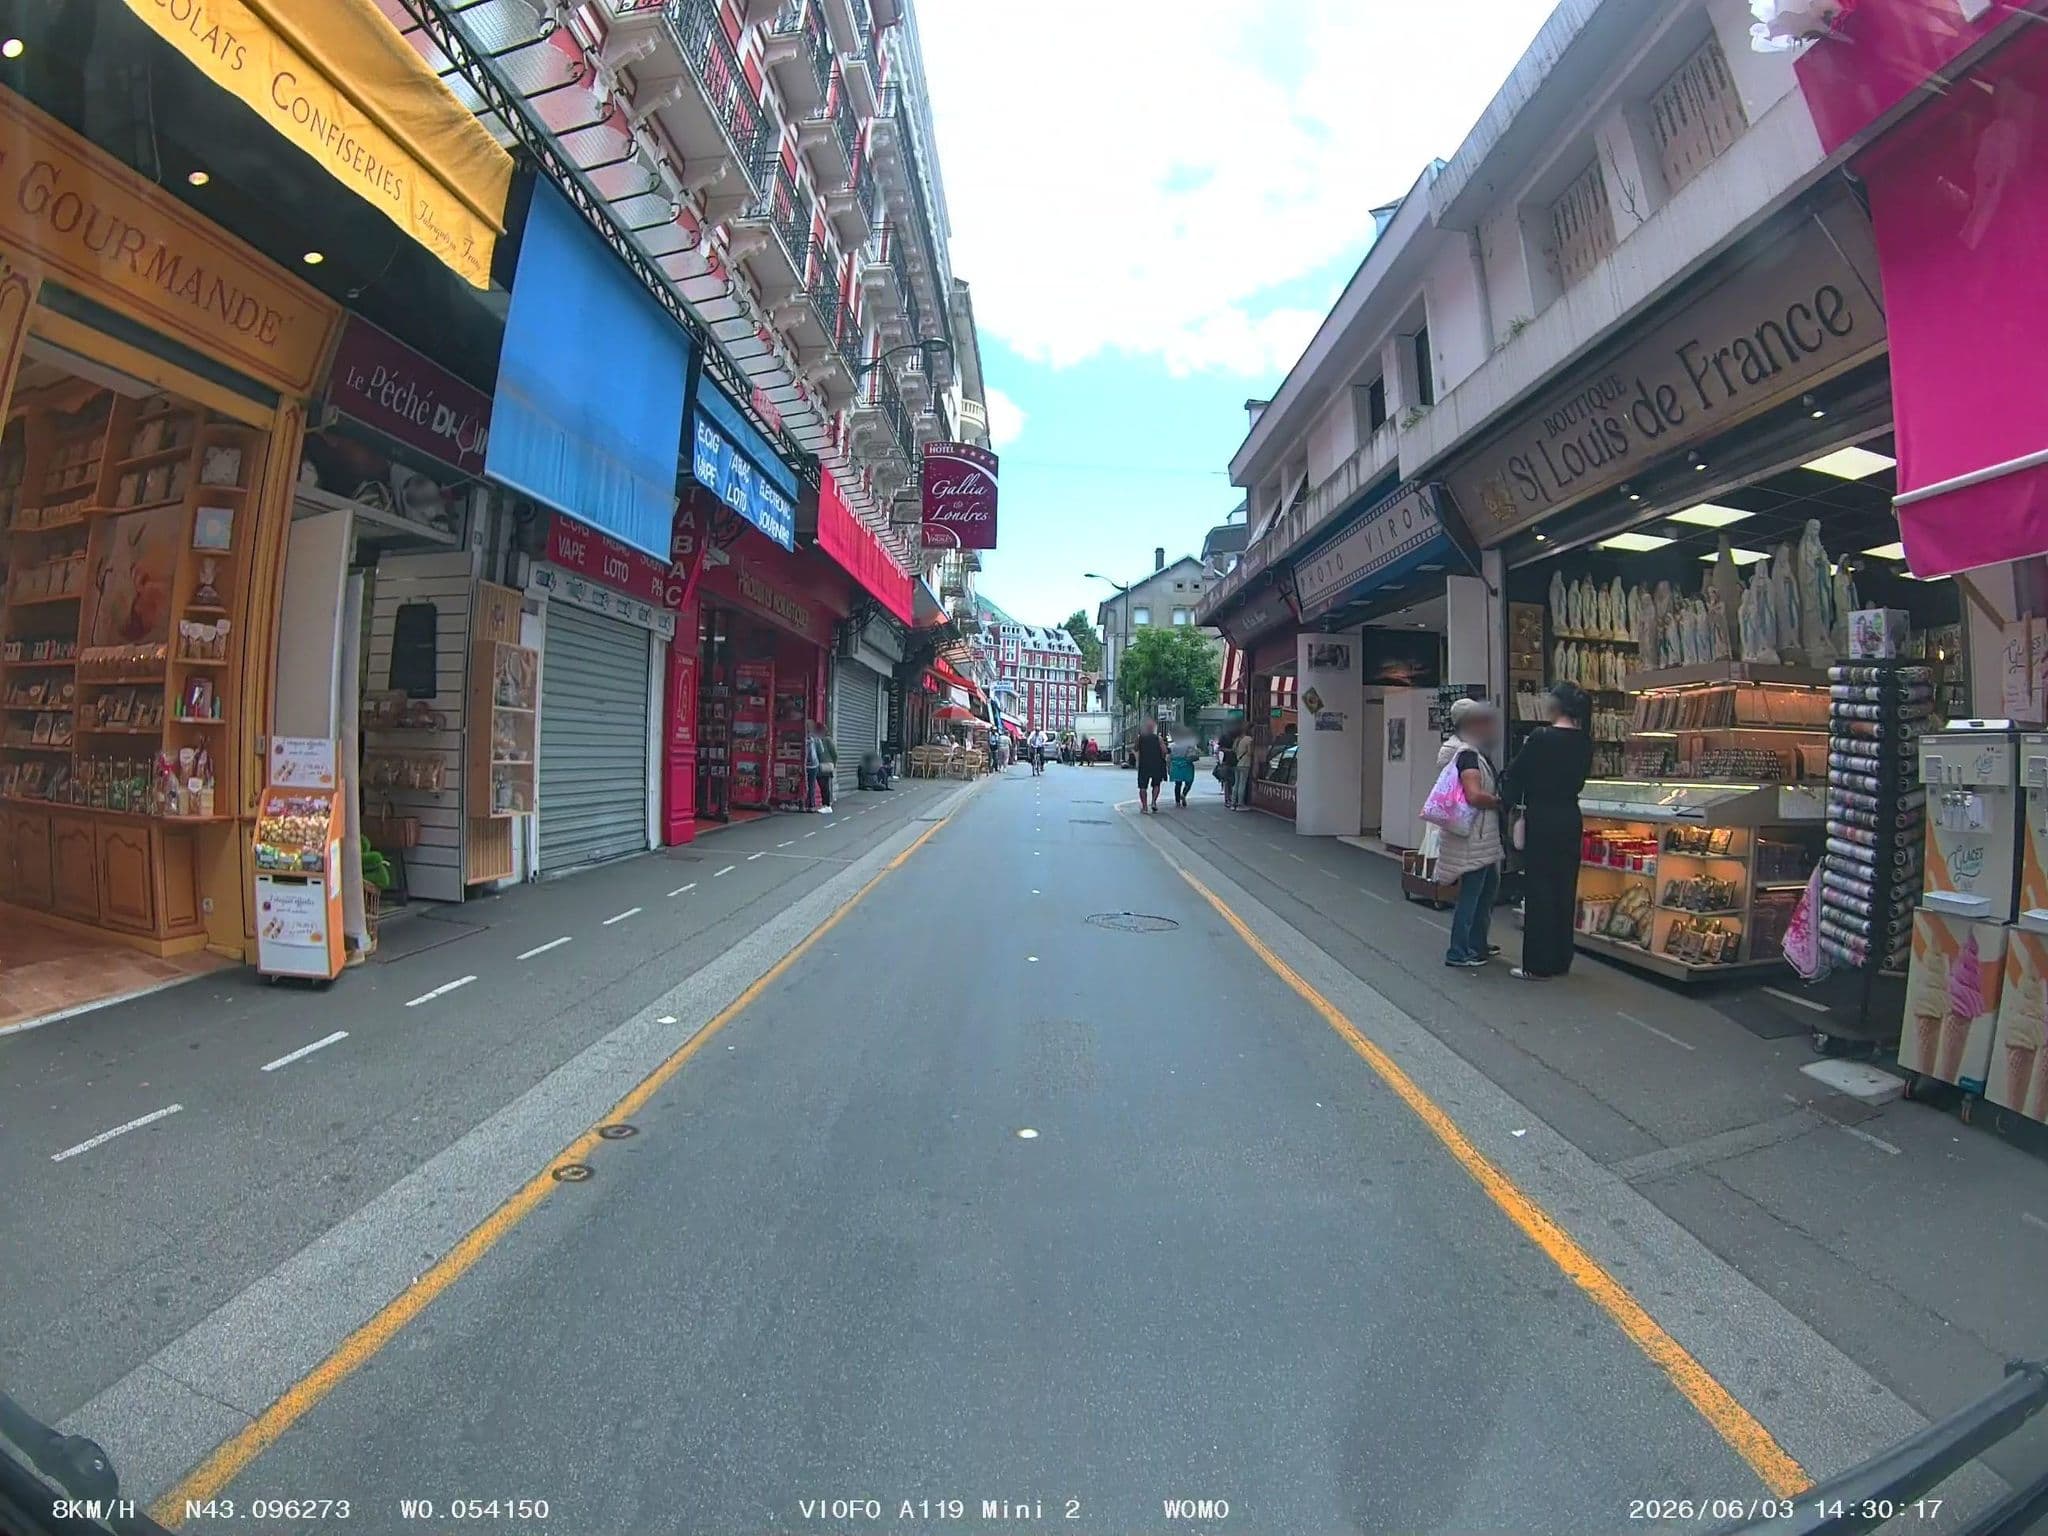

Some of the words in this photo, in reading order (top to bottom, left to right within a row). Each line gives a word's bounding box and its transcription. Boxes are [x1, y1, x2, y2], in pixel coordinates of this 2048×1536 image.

[154, 0, 247, 71] OLATS
[271, 71, 403, 201] CONFISERIES
[17, 160, 283, 346] GOURMANDE
[364, 365, 435, 426] Péché
[1535, 415, 1629, 489] Louis
[1631, 375, 1686, 441] de
[1676, 284, 1854, 411] France
[1543, 374, 1627, 437] BOUTIQUE
[930, 502, 989, 522] Londres
[932, 473, 988, 499] Gallia
[558, 535, 586, 566] VAPE
[603, 555, 630, 583] LOTO
[664, 486, 700, 607] TABAC
